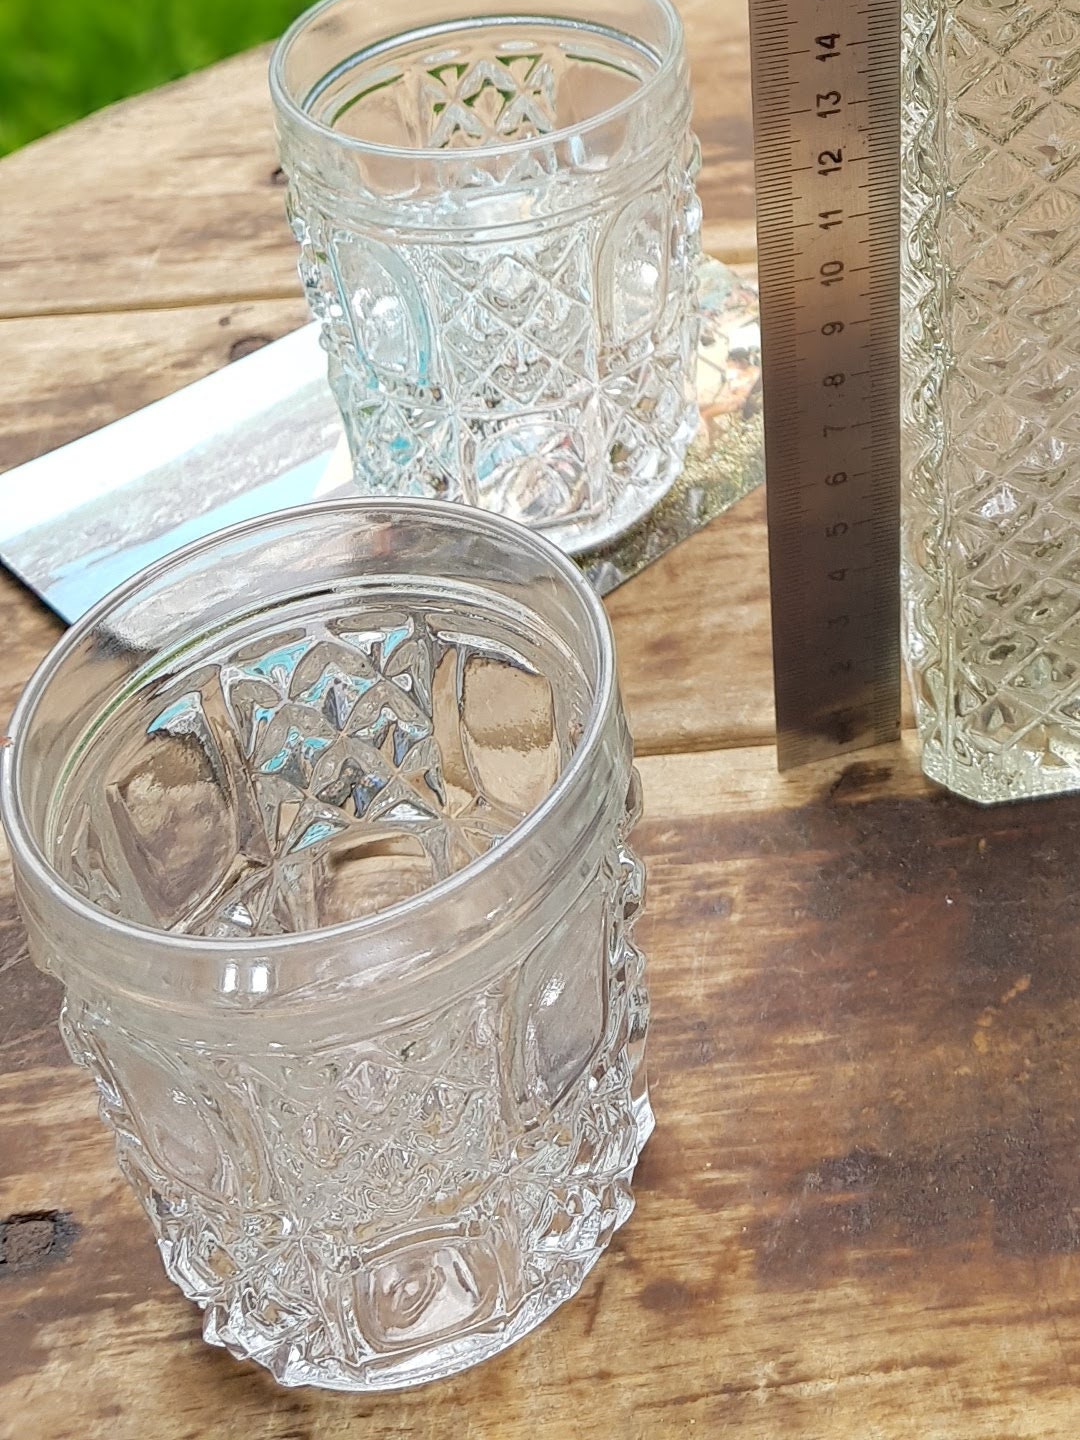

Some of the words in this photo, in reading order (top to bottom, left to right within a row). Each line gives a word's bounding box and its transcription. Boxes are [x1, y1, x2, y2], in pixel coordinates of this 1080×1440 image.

[814, 33, 841, 63] 14
[815, 90, 842, 119] 13
[817, 148, 843, 177] 12
[818, 209, 843, 231] 11
[819, 260, 845, 287] 10
[820, 320, 845, 337] 9
[822, 372, 846, 389] 8
[822, 424, 847, 439] 7
[824, 471, 848, 488] 6
[825, 522, 850, 538] 5
[826, 567, 850, 583] 4
